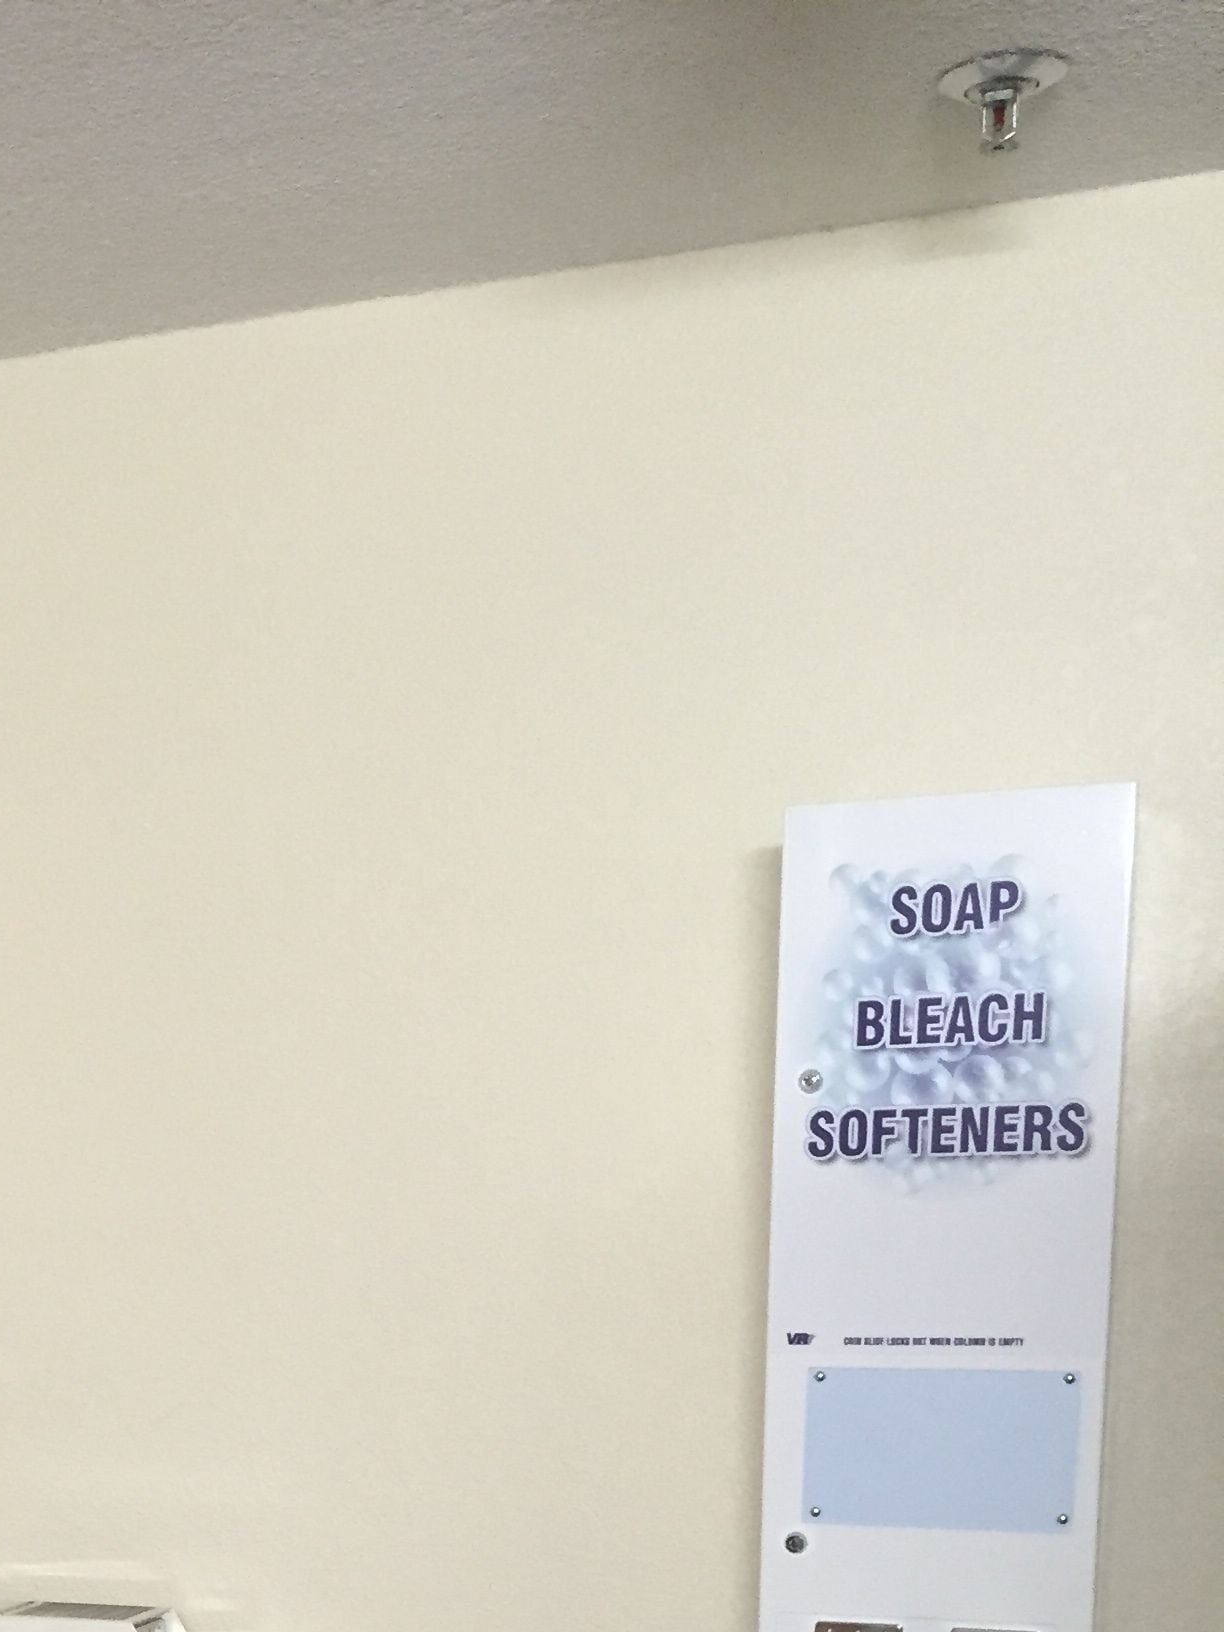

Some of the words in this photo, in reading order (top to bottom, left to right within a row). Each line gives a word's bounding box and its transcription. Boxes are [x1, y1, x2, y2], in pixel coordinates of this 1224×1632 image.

[889, 880, 1020, 936] SOAP
[855, 991, 1045, 1047] BLEACH
[807, 1102, 1086, 1158] SOFTENERS
